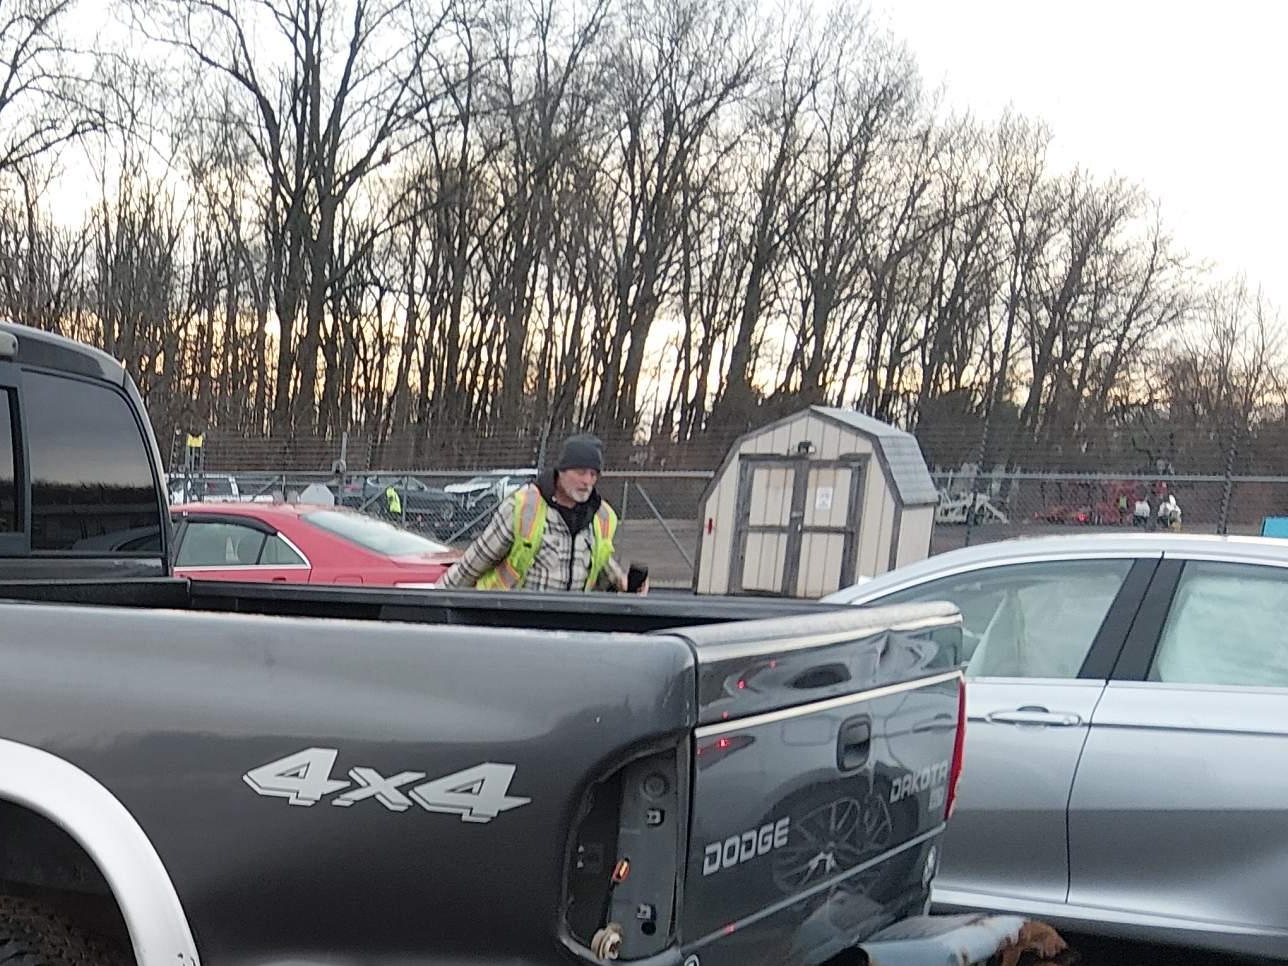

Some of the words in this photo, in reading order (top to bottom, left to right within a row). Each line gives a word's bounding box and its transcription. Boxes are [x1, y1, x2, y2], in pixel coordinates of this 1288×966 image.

[242, 747, 532, 823] 4x4
[889, 760, 948, 804] DAKOTA
[703, 816, 790, 876] DODGE
